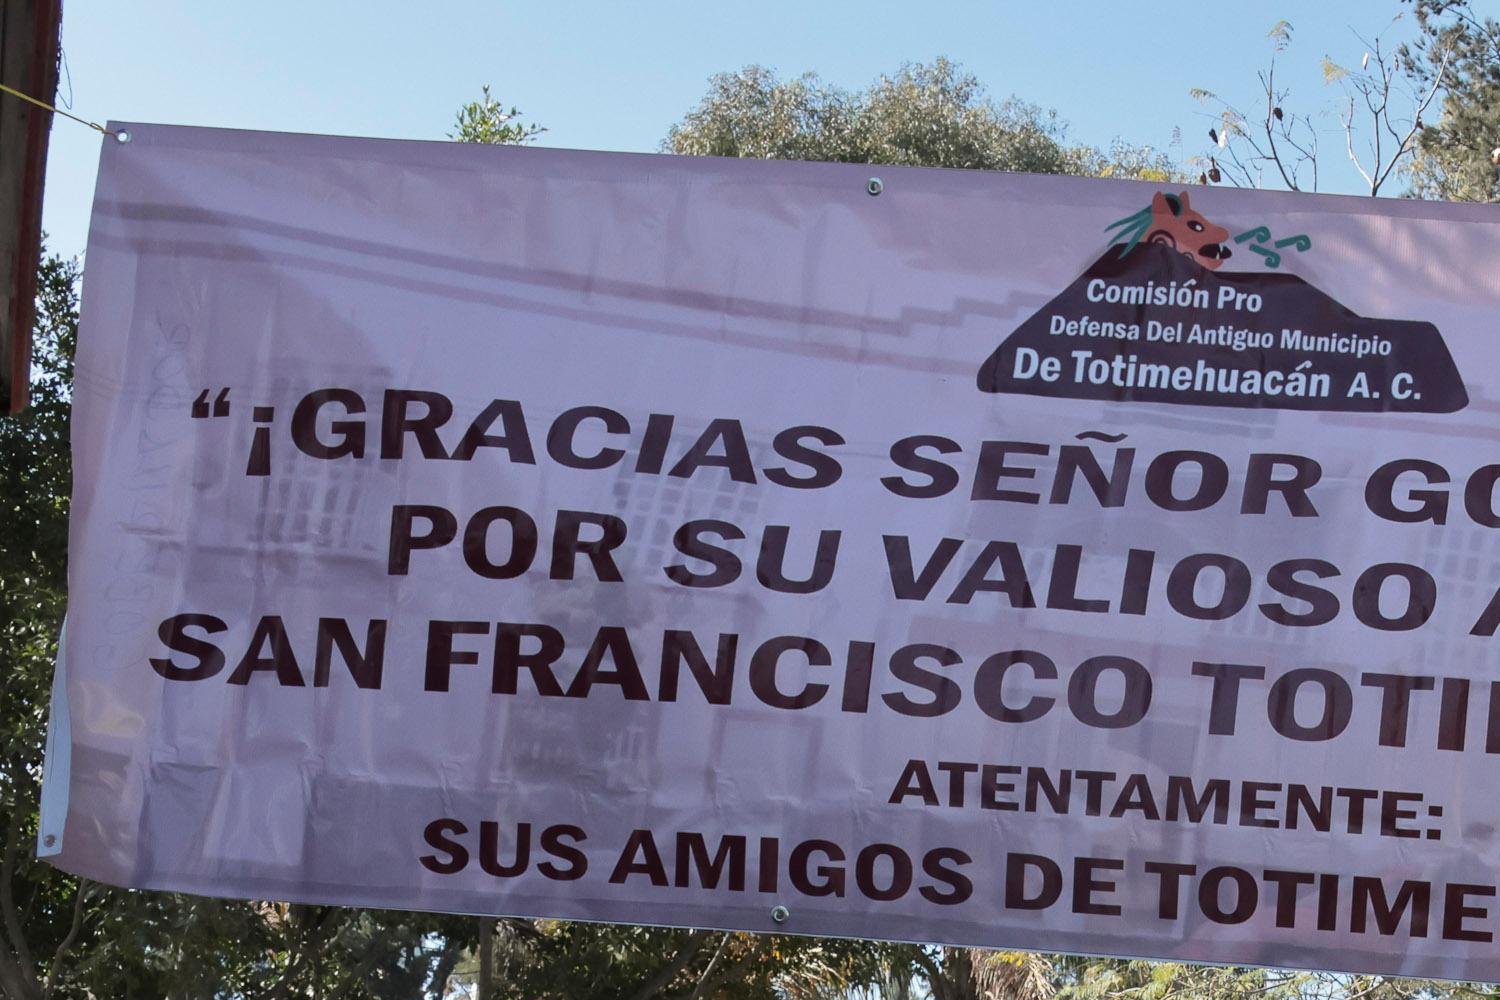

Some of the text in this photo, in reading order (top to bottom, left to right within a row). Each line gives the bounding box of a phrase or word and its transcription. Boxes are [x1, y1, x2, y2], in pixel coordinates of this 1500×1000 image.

[1050, 316, 1391, 358] Defensa Del Antiguo Municipio
[1088, 279, 1261, 312] Comisión Pro
[1014, 348, 1420, 399] De Totimehuacán A. C.
[879, 431, 1322, 518] SEÑOR
[387, 504, 628, 583] POR
[663, 519, 842, 594] SU
[882, 534, 1437, 632] VALIOSO
[148, 613, 388, 693] SAN
[423, 619, 1153, 729] FRANCISCO
[887, 759, 1443, 841] ATENTAMENTE:
[418, 817, 589, 882] SUS
[607, 828, 974, 906] AMIGOS
[1004, 851, 1125, 917] DE
